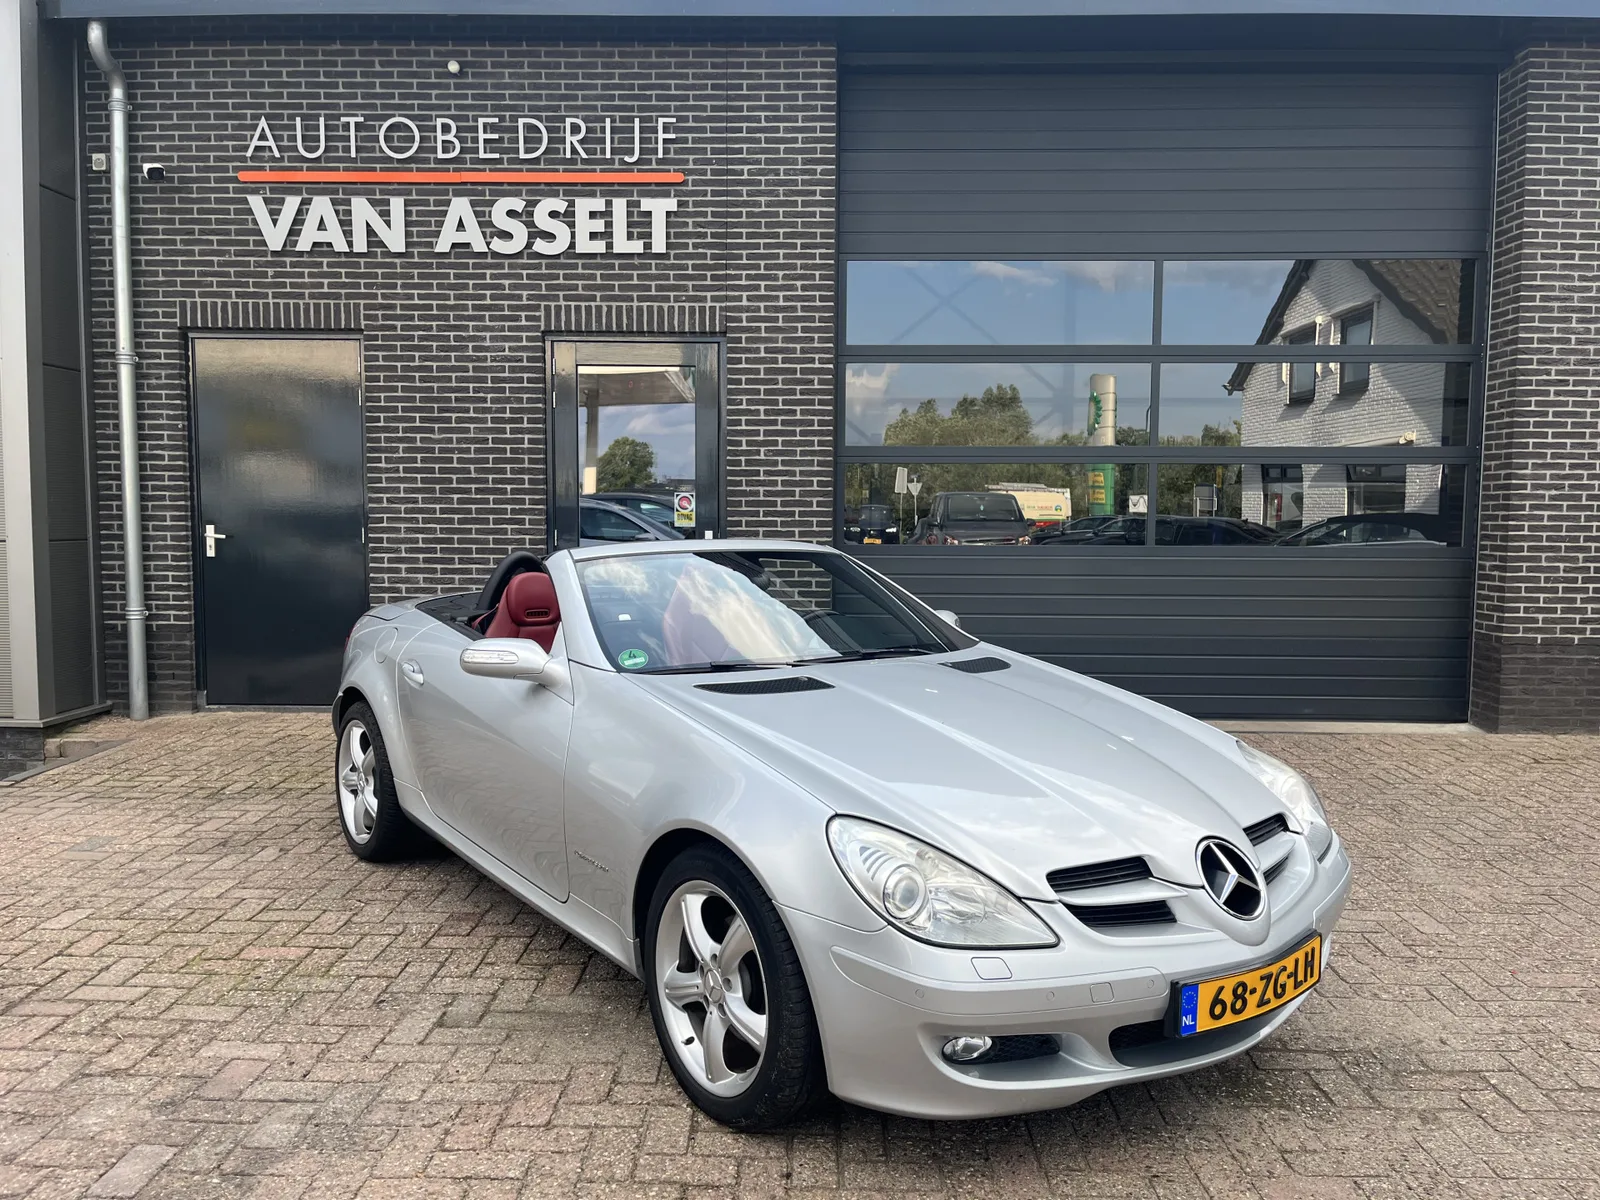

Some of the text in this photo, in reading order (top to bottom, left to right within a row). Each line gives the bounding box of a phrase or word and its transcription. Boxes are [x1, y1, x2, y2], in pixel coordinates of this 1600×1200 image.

[245, 115, 677, 163] AUTOBEDRIJF
[246, 195, 677, 255] VAN ASSELT
[1209, 946, 1316, 1020] 68-ZG-LH
[1182, 1014, 1195, 1027] NL
